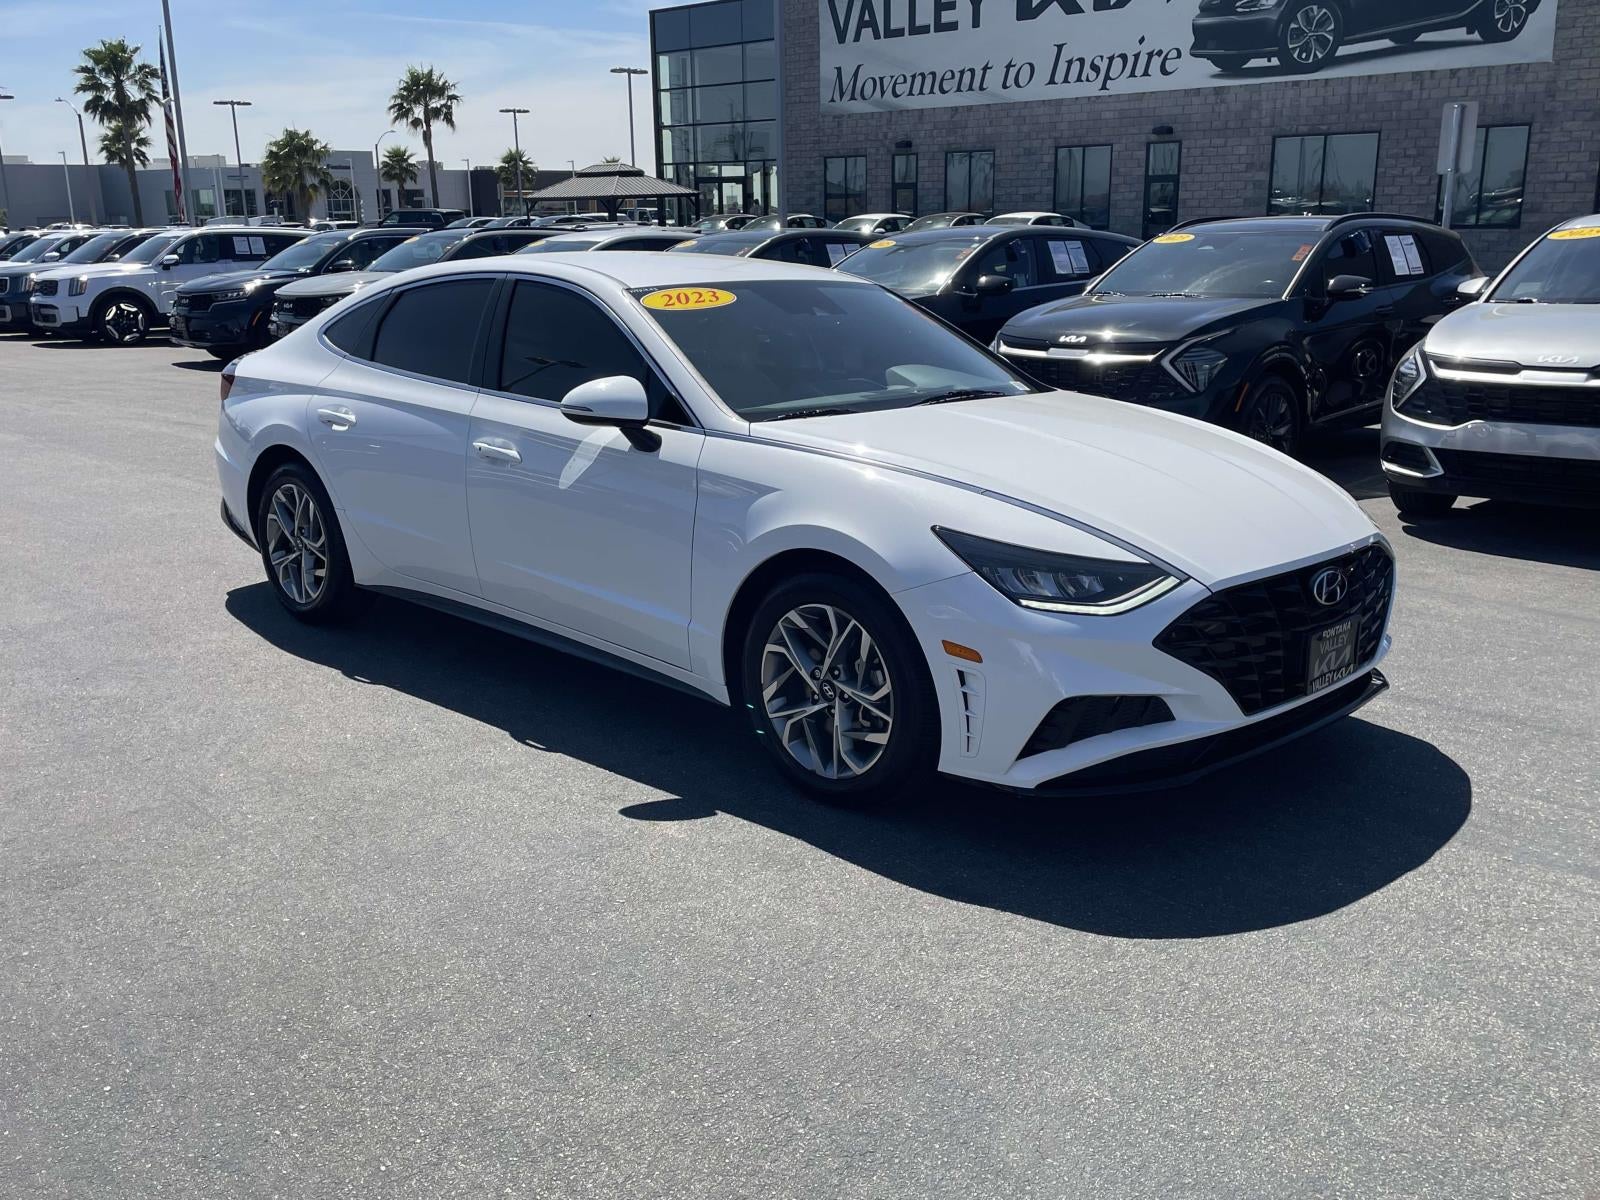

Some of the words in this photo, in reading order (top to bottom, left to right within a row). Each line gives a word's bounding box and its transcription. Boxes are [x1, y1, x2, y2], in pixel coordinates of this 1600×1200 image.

[828, 0, 983, 44] VALLEY
[828, 60, 993, 103] Movement
[1001, 57, 1035, 90] to
[1045, 35, 1182, 91] Inspire
[660, 290, 720, 307] 2023
[1322, 620, 1351, 638] FONTANA
[1320, 631, 1349, 655] VALLEY
[1312, 671, 1333, 693] VALLEY
